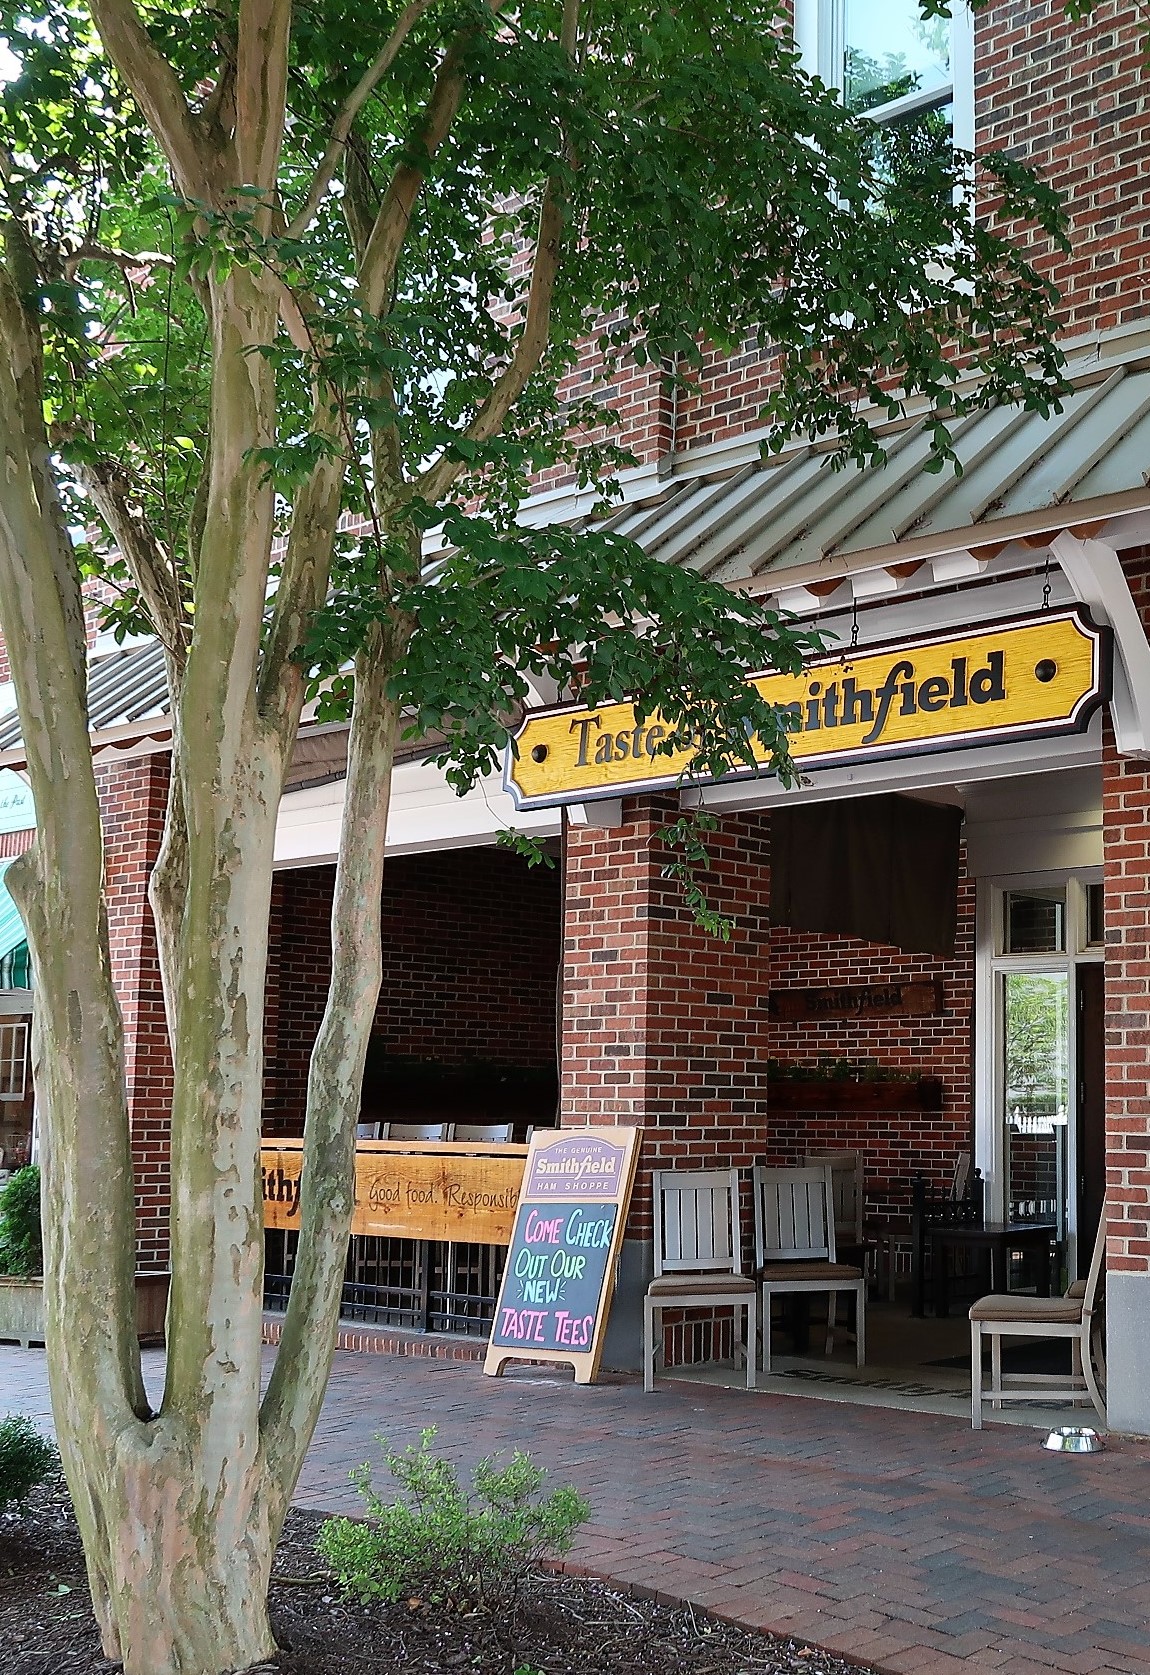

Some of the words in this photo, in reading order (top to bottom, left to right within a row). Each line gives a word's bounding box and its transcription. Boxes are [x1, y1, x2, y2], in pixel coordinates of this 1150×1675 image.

[568, 714, 666, 768] Taste
[728, 650, 1007, 744] mithfield
[571, 1146, 603, 1154] GENUINE
[535, 1155, 616, 1180] Smithfield
[368, 1178, 400, 1212] Good
[405, 1181, 438, 1209] food.
[444, 1183, 519, 1214] Responsib
[536, 1182, 557, 1191] HAM
[564, 1181, 609, 1191] SHOPPE
[523, 1277, 560, 1304] NEW
[500, 1307, 548, 1342] TASTE
[554, 1310, 593, 1346] TEES
